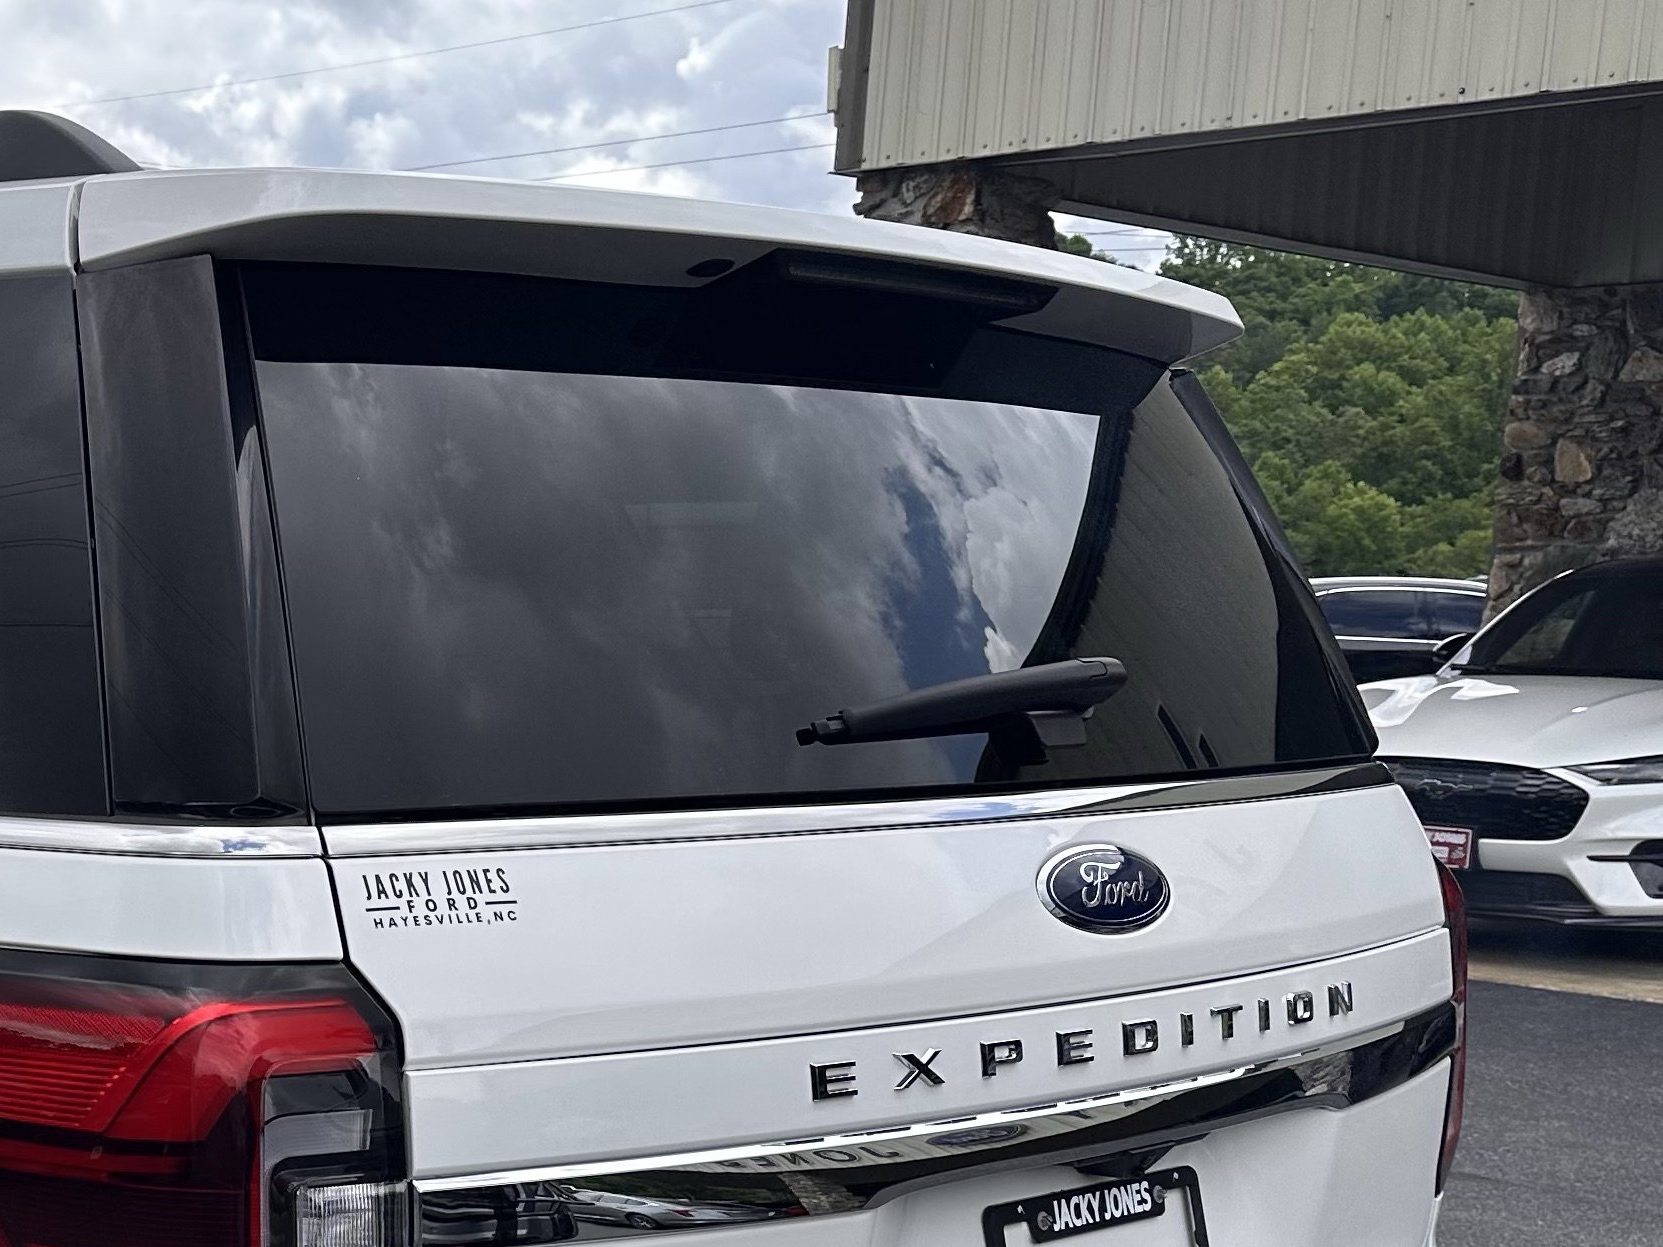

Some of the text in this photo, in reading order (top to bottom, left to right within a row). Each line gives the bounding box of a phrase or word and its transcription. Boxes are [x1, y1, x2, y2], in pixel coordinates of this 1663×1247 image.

[362, 867, 510, 900] JACKY JONES
[407, 896, 478, 914] FORD
[1080, 861, 1149, 907] Ford
[810, 980, 1353, 1102] EXPEDITION
[1052, 1180, 1152, 1232] JACKY JONES
